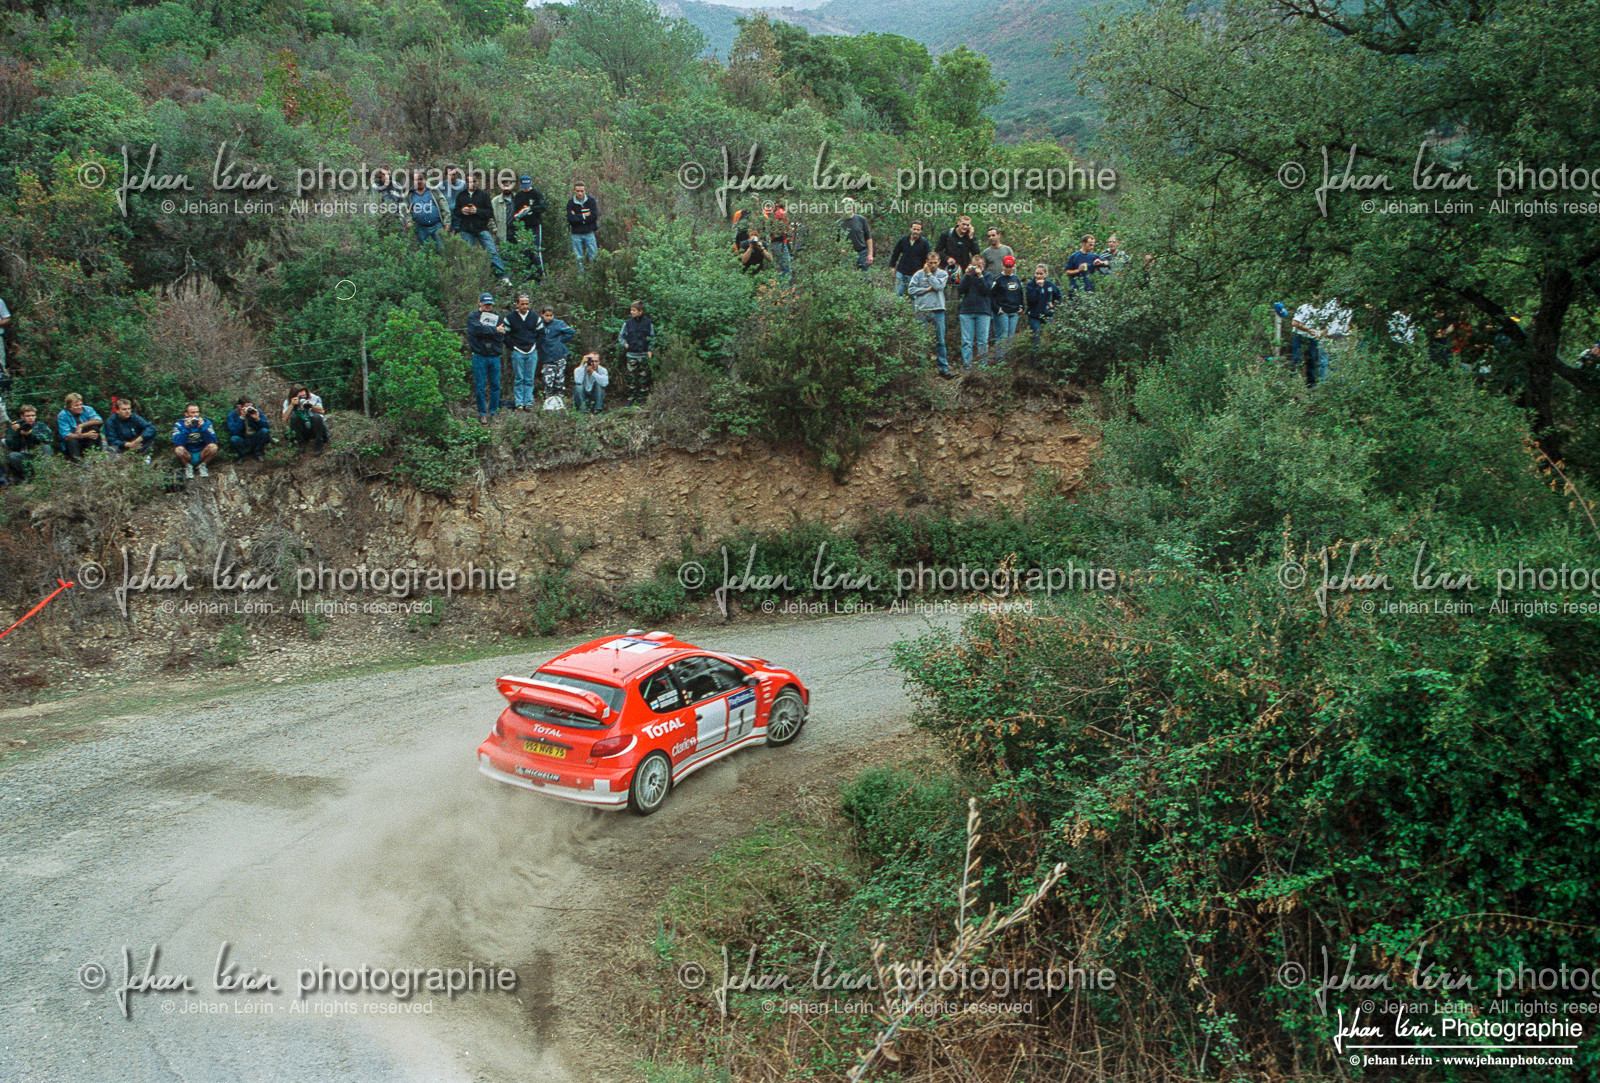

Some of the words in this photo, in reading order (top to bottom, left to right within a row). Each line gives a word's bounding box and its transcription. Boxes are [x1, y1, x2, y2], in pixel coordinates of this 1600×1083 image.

[533, 723, 562, 738] TOTAL
[641, 717, 686, 740] TOTAL
[524, 768, 560, 781] MICHELIN
